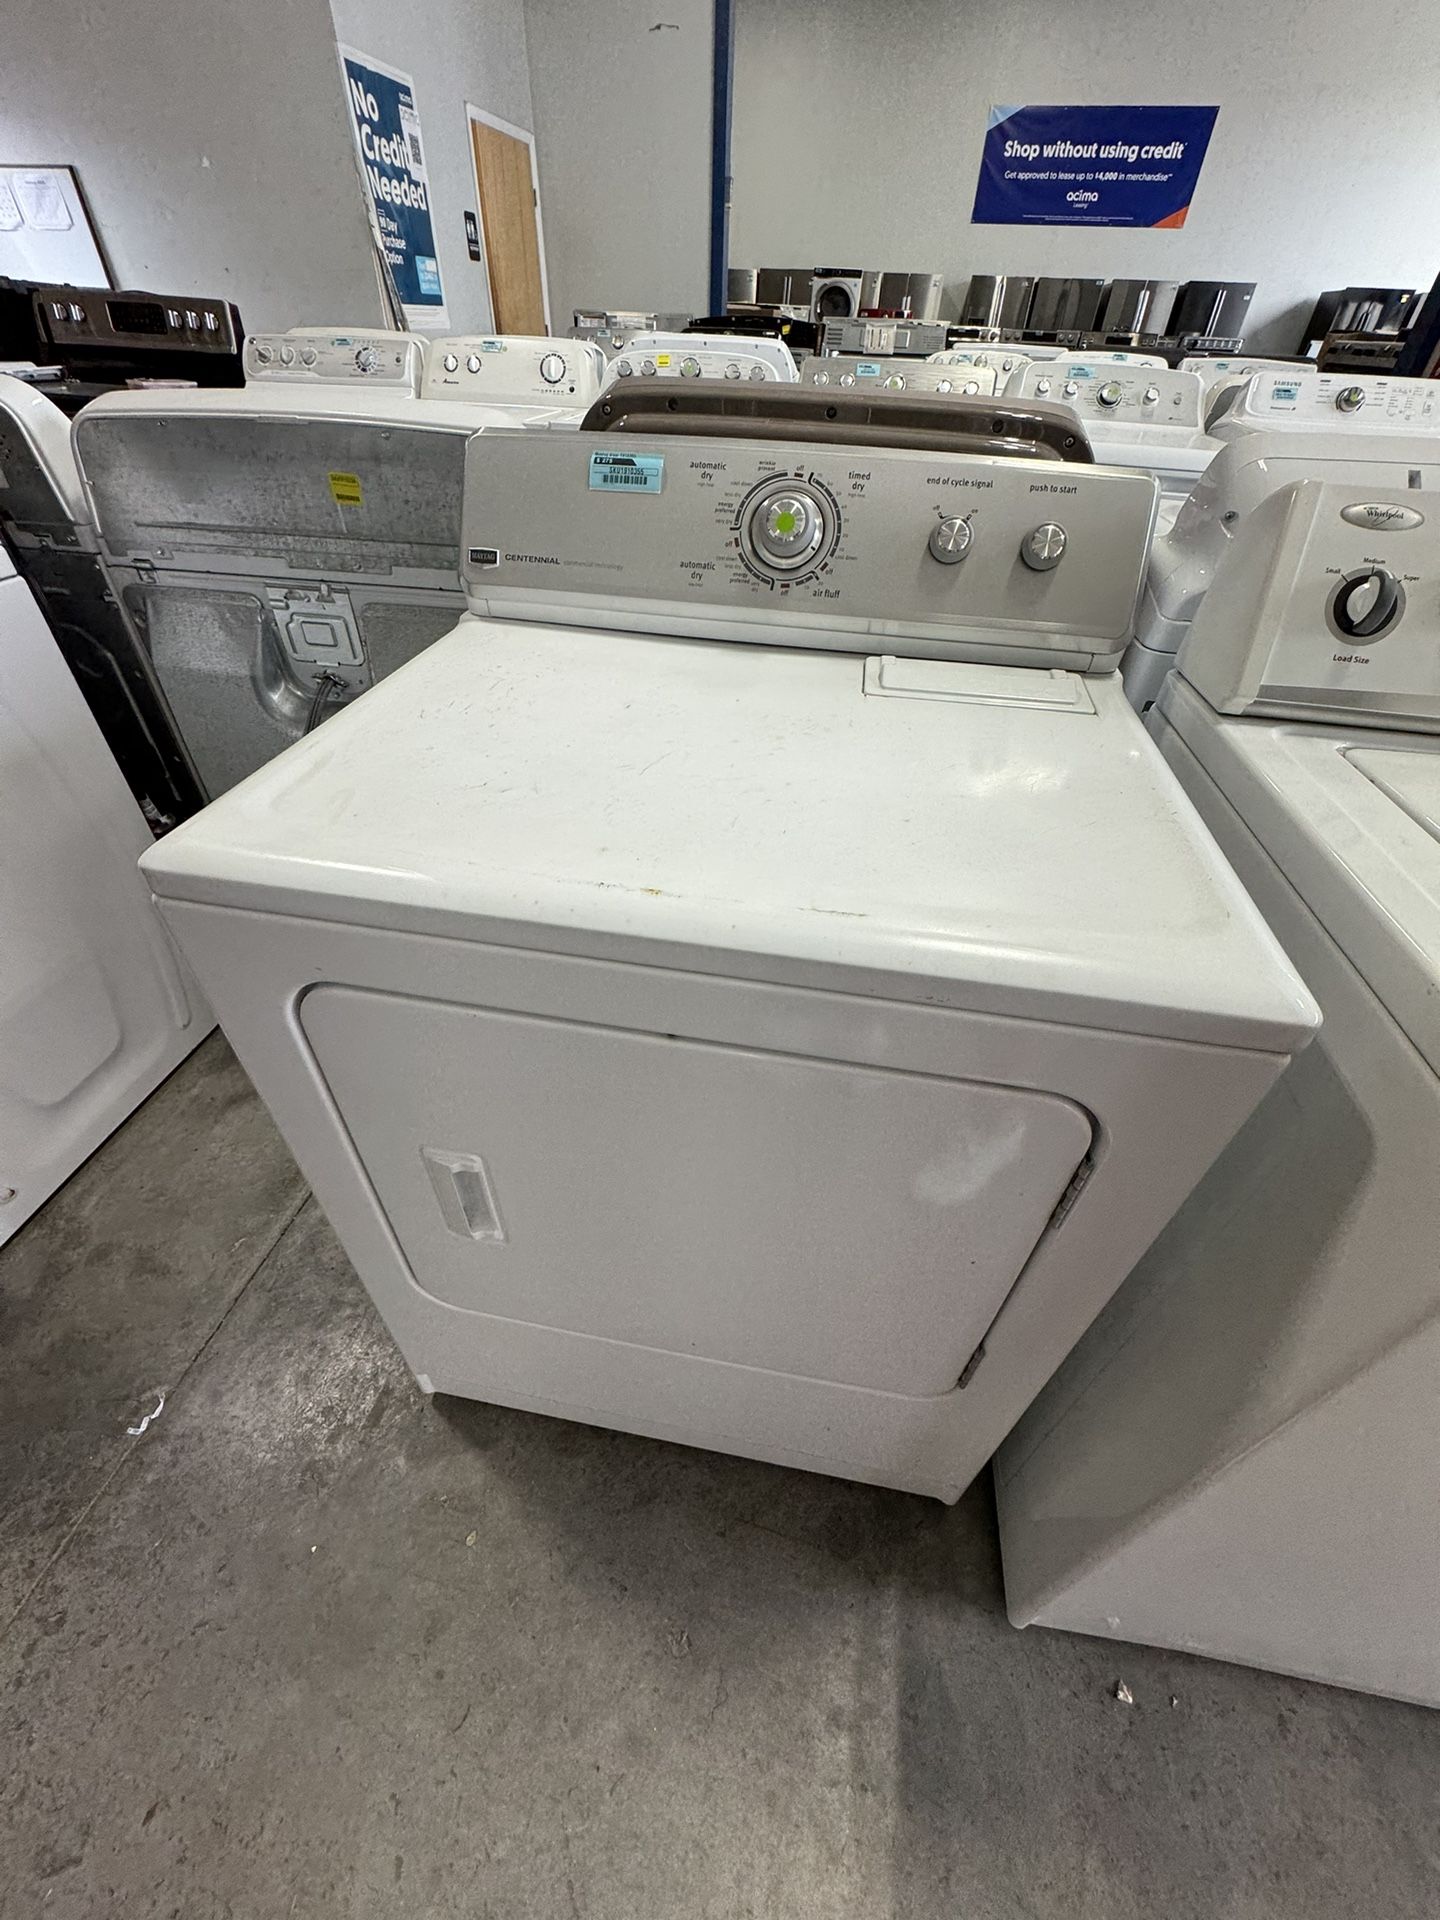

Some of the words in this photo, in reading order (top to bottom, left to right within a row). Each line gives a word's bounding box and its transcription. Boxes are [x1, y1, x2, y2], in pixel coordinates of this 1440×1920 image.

[350, 77, 379, 122] No
[361, 123, 410, 171] Credit
[1003, 140, 1040, 161] Shop
[1043, 140, 1098, 158] without
[1100, 141, 1140, 162] using
[1005, 170, 1016, 179] Get
[1017, 171, 1049, 181] approved
[1050, 171, 1057, 180] to
[1058, 171, 1075, 180] lease
[1076, 173, 1085, 182] up
[1086, 172, 1094, 180] to
[1118, 172, 1125, 180] in
[367, 164, 427, 211] Needed
[1066, 189, 1098, 202] acima
[690, 461, 727, 470] automatic
[701, 471, 713, 481] dry
[848, 470, 871, 480] timed
[852, 481, 865, 492] dry
[927, 477, 941, 485] end
[942, 477, 950, 485] of
[951, 478, 970, 488] cycle
[971, 479, 993, 490] signal
[1029, 484, 1049, 493] push
[1050, 484, 1058, 492] to
[1059, 485, 1078, 494] start
[1366, 509, 1404, 520] Whirlpool
[472, 551, 496, 560] MAYTAG
[505, 553, 561, 565] CENTENNIAL
[680, 560, 716, 571] automatic
[691, 571, 703, 581] dry
[825, 568, 834, 576] off
[1325, 566, 1341, 576] Small
[1403, 574, 1420, 582] Super
[780, 589, 789, 597] off
[812, 589, 823, 597] air
[824, 589, 840, 599] fluff
[1332, 654, 1353, 663] Load
[1353, 656, 1370, 664] Size
